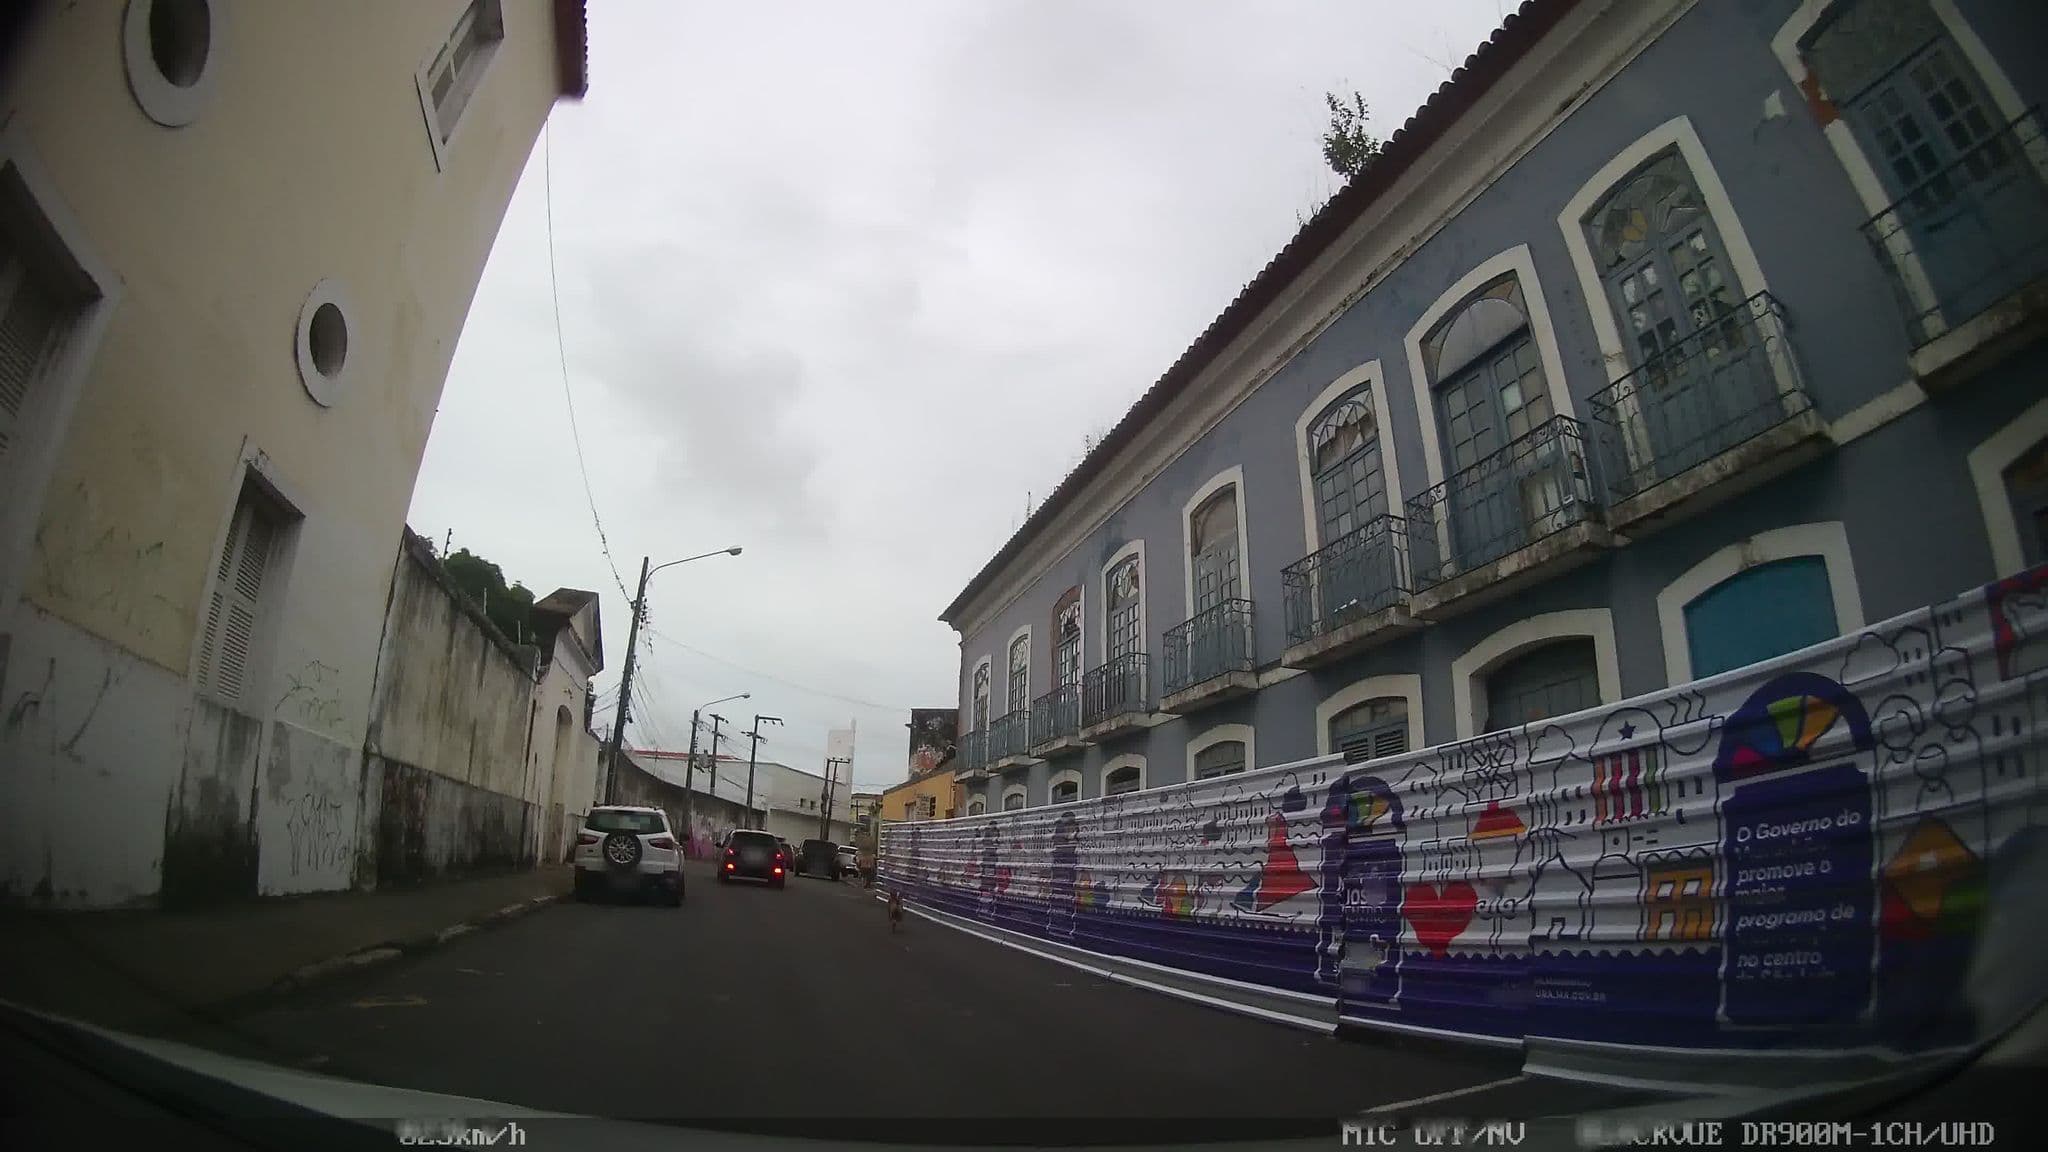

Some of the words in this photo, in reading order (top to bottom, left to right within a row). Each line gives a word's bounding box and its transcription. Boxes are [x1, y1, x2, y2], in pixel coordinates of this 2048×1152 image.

[1736, 826, 1751, 843] O
[1755, 816, 1833, 840] Governo
[1836, 808, 1862, 827] do
[1736, 862, 1815, 886] promove
[1819, 859, 1832, 873] o
[1830, 902, 1856, 920] de
[1737, 952, 1759, 968] no
[1762, 949, 1823, 967] centro
